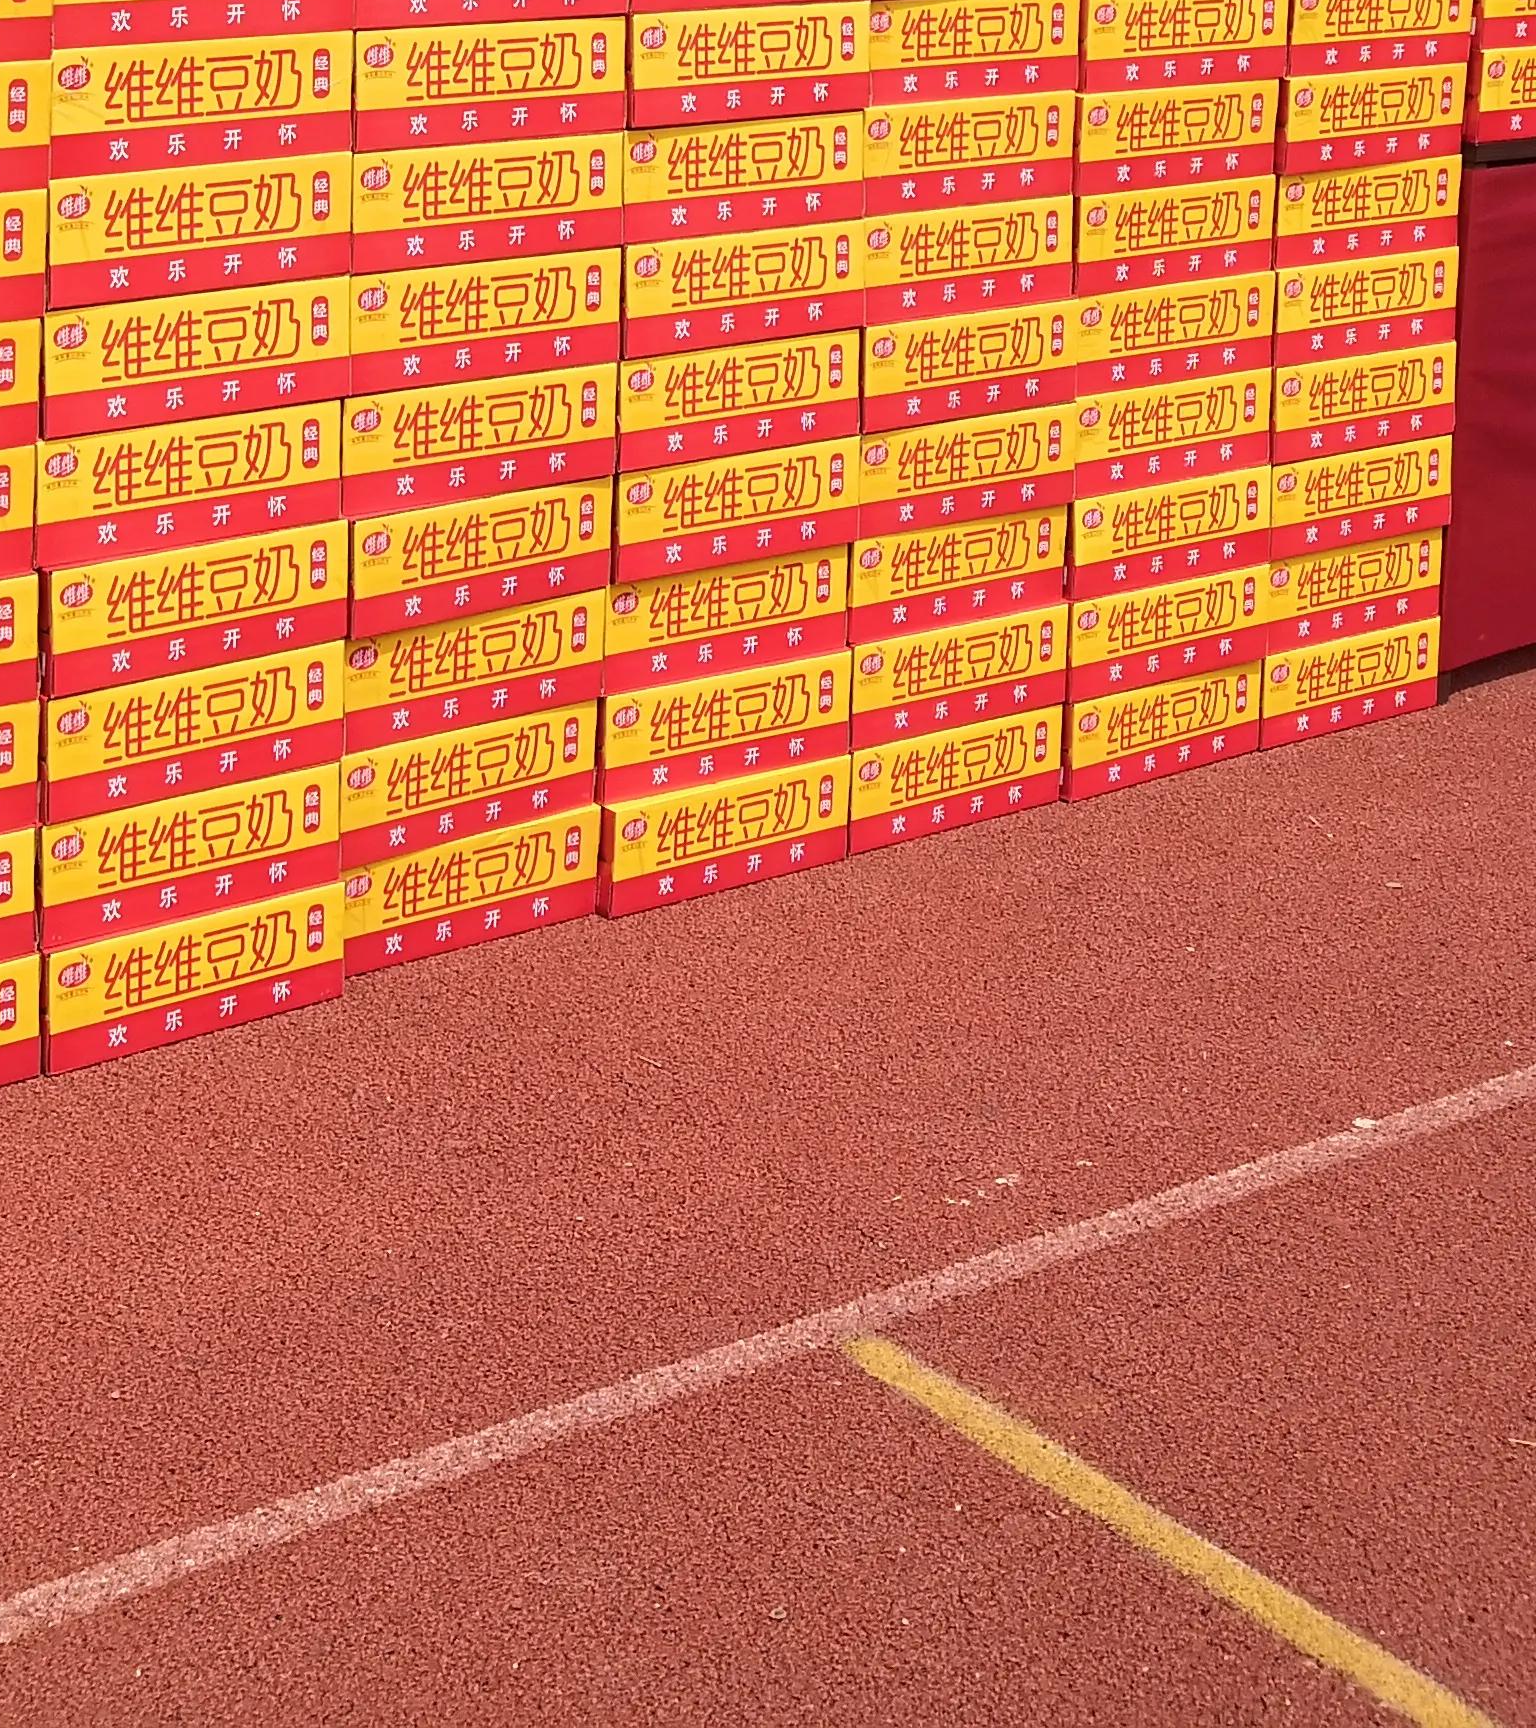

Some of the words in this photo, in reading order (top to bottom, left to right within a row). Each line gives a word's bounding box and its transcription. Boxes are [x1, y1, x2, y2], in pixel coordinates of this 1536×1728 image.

[406, 29, 583, 103] 维维豆奶
[900, 0, 1044, 63] 维维豆奶
[1113, 189, 1243, 254] 维维豆奶
[670, 232, 828, 308] 维维豆奶
[99, 295, 302, 383] 维维豆奶
[1306, 354, 1428, 424] 维维豆奶
[895, 418, 1042, 495] 维维豆奶
[402, 495, 572, 583] 维维豆奶
[1105, 576, 1238, 655] 维维豆奶
[98, 785, 293, 890] 维维豆奶
